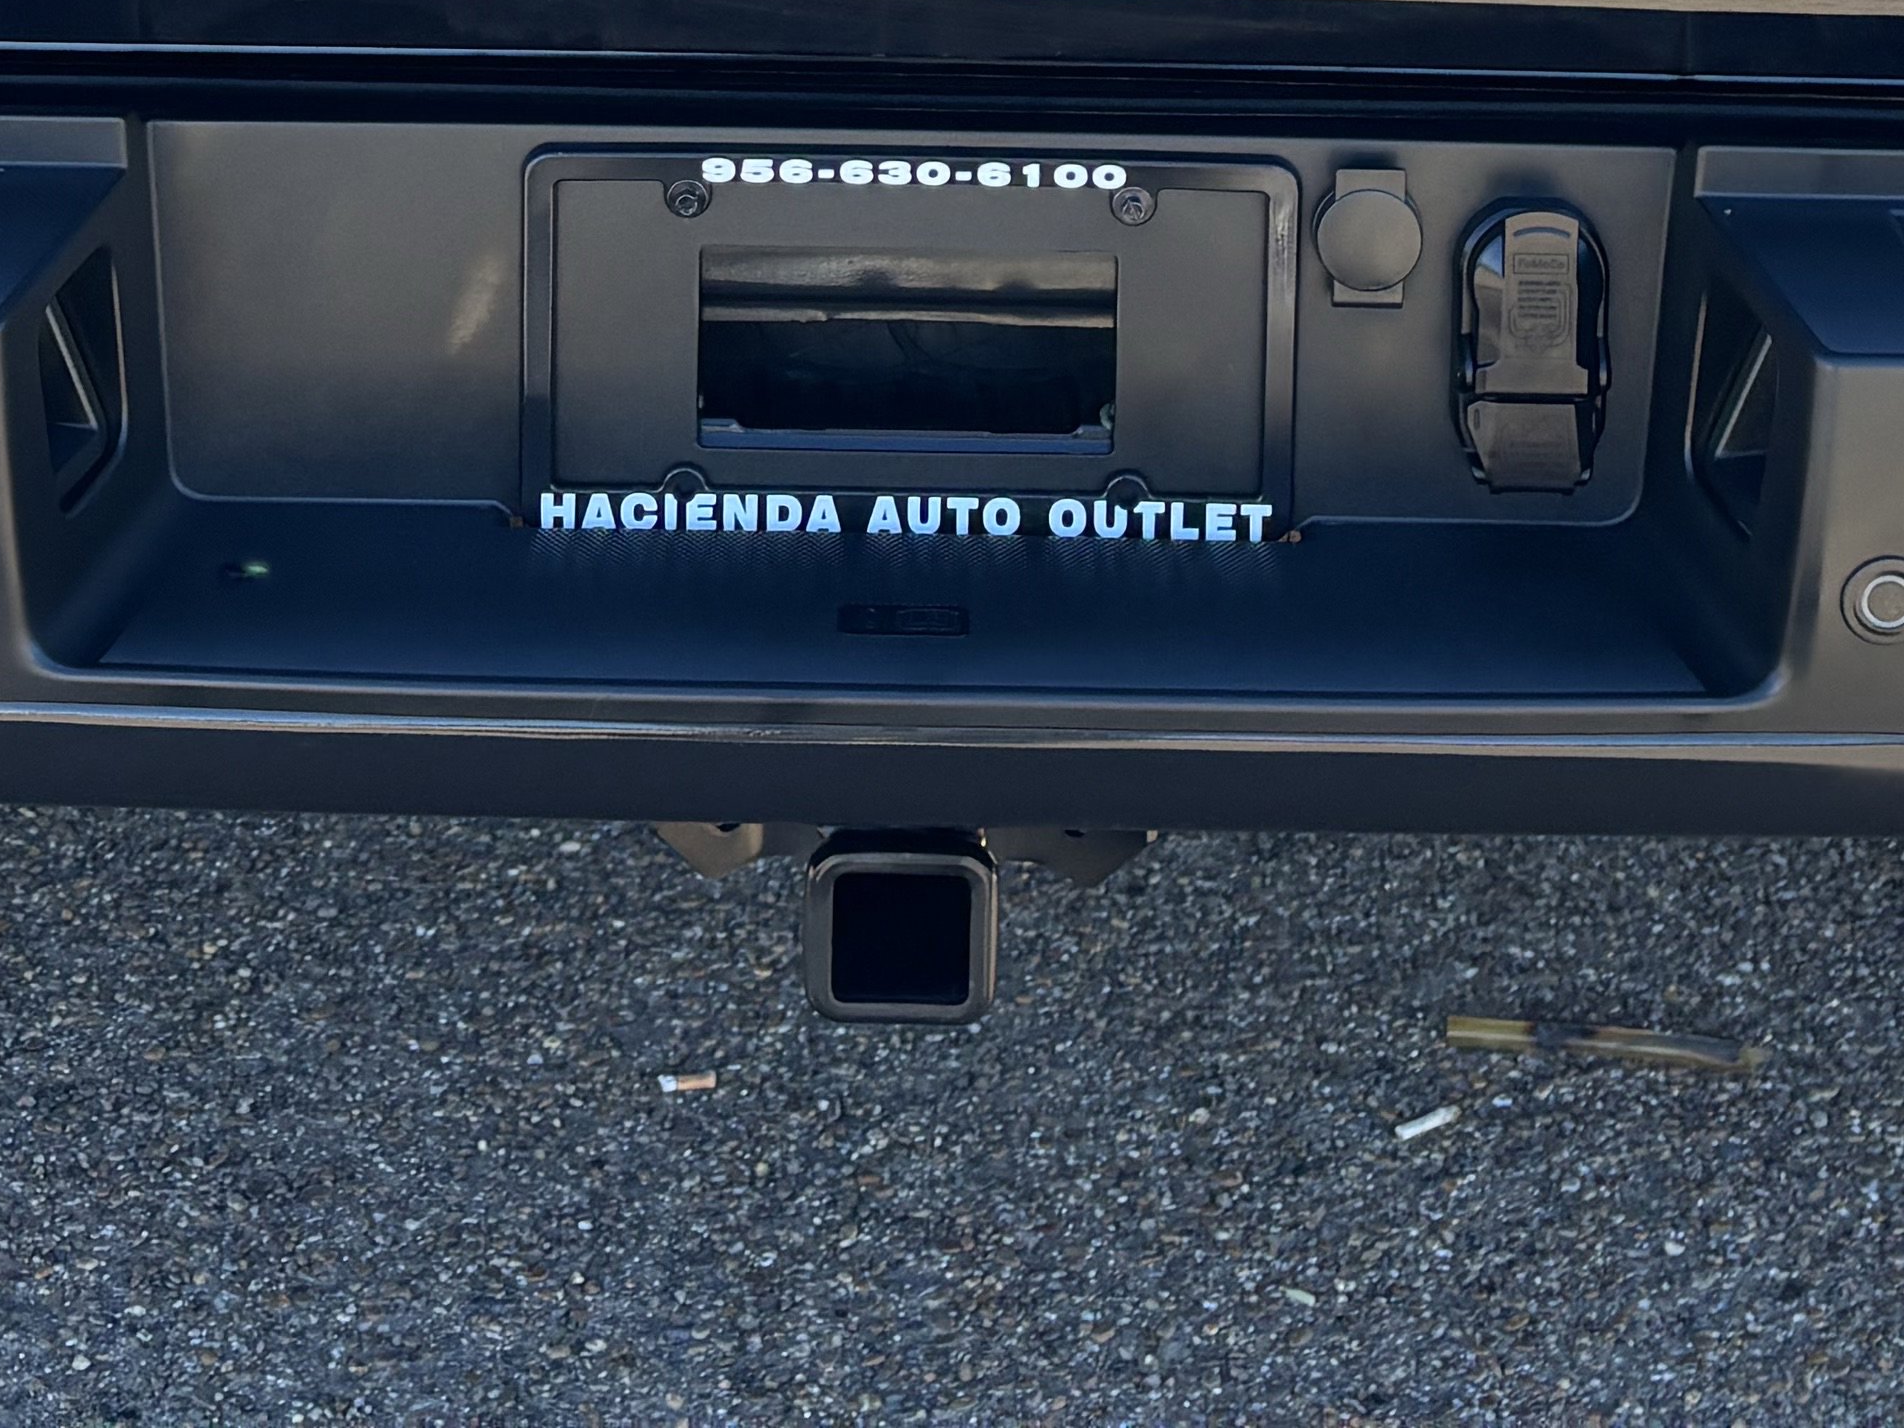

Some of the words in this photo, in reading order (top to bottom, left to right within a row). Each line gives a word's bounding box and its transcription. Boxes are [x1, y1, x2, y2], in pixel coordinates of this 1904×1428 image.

[701, 157, 1127, 190] 956-630-6100
[539, 492, 842, 534] HACIENDA
[866, 495, 1021, 537] AUTO
[1048, 498, 1273, 542] OUTLET
